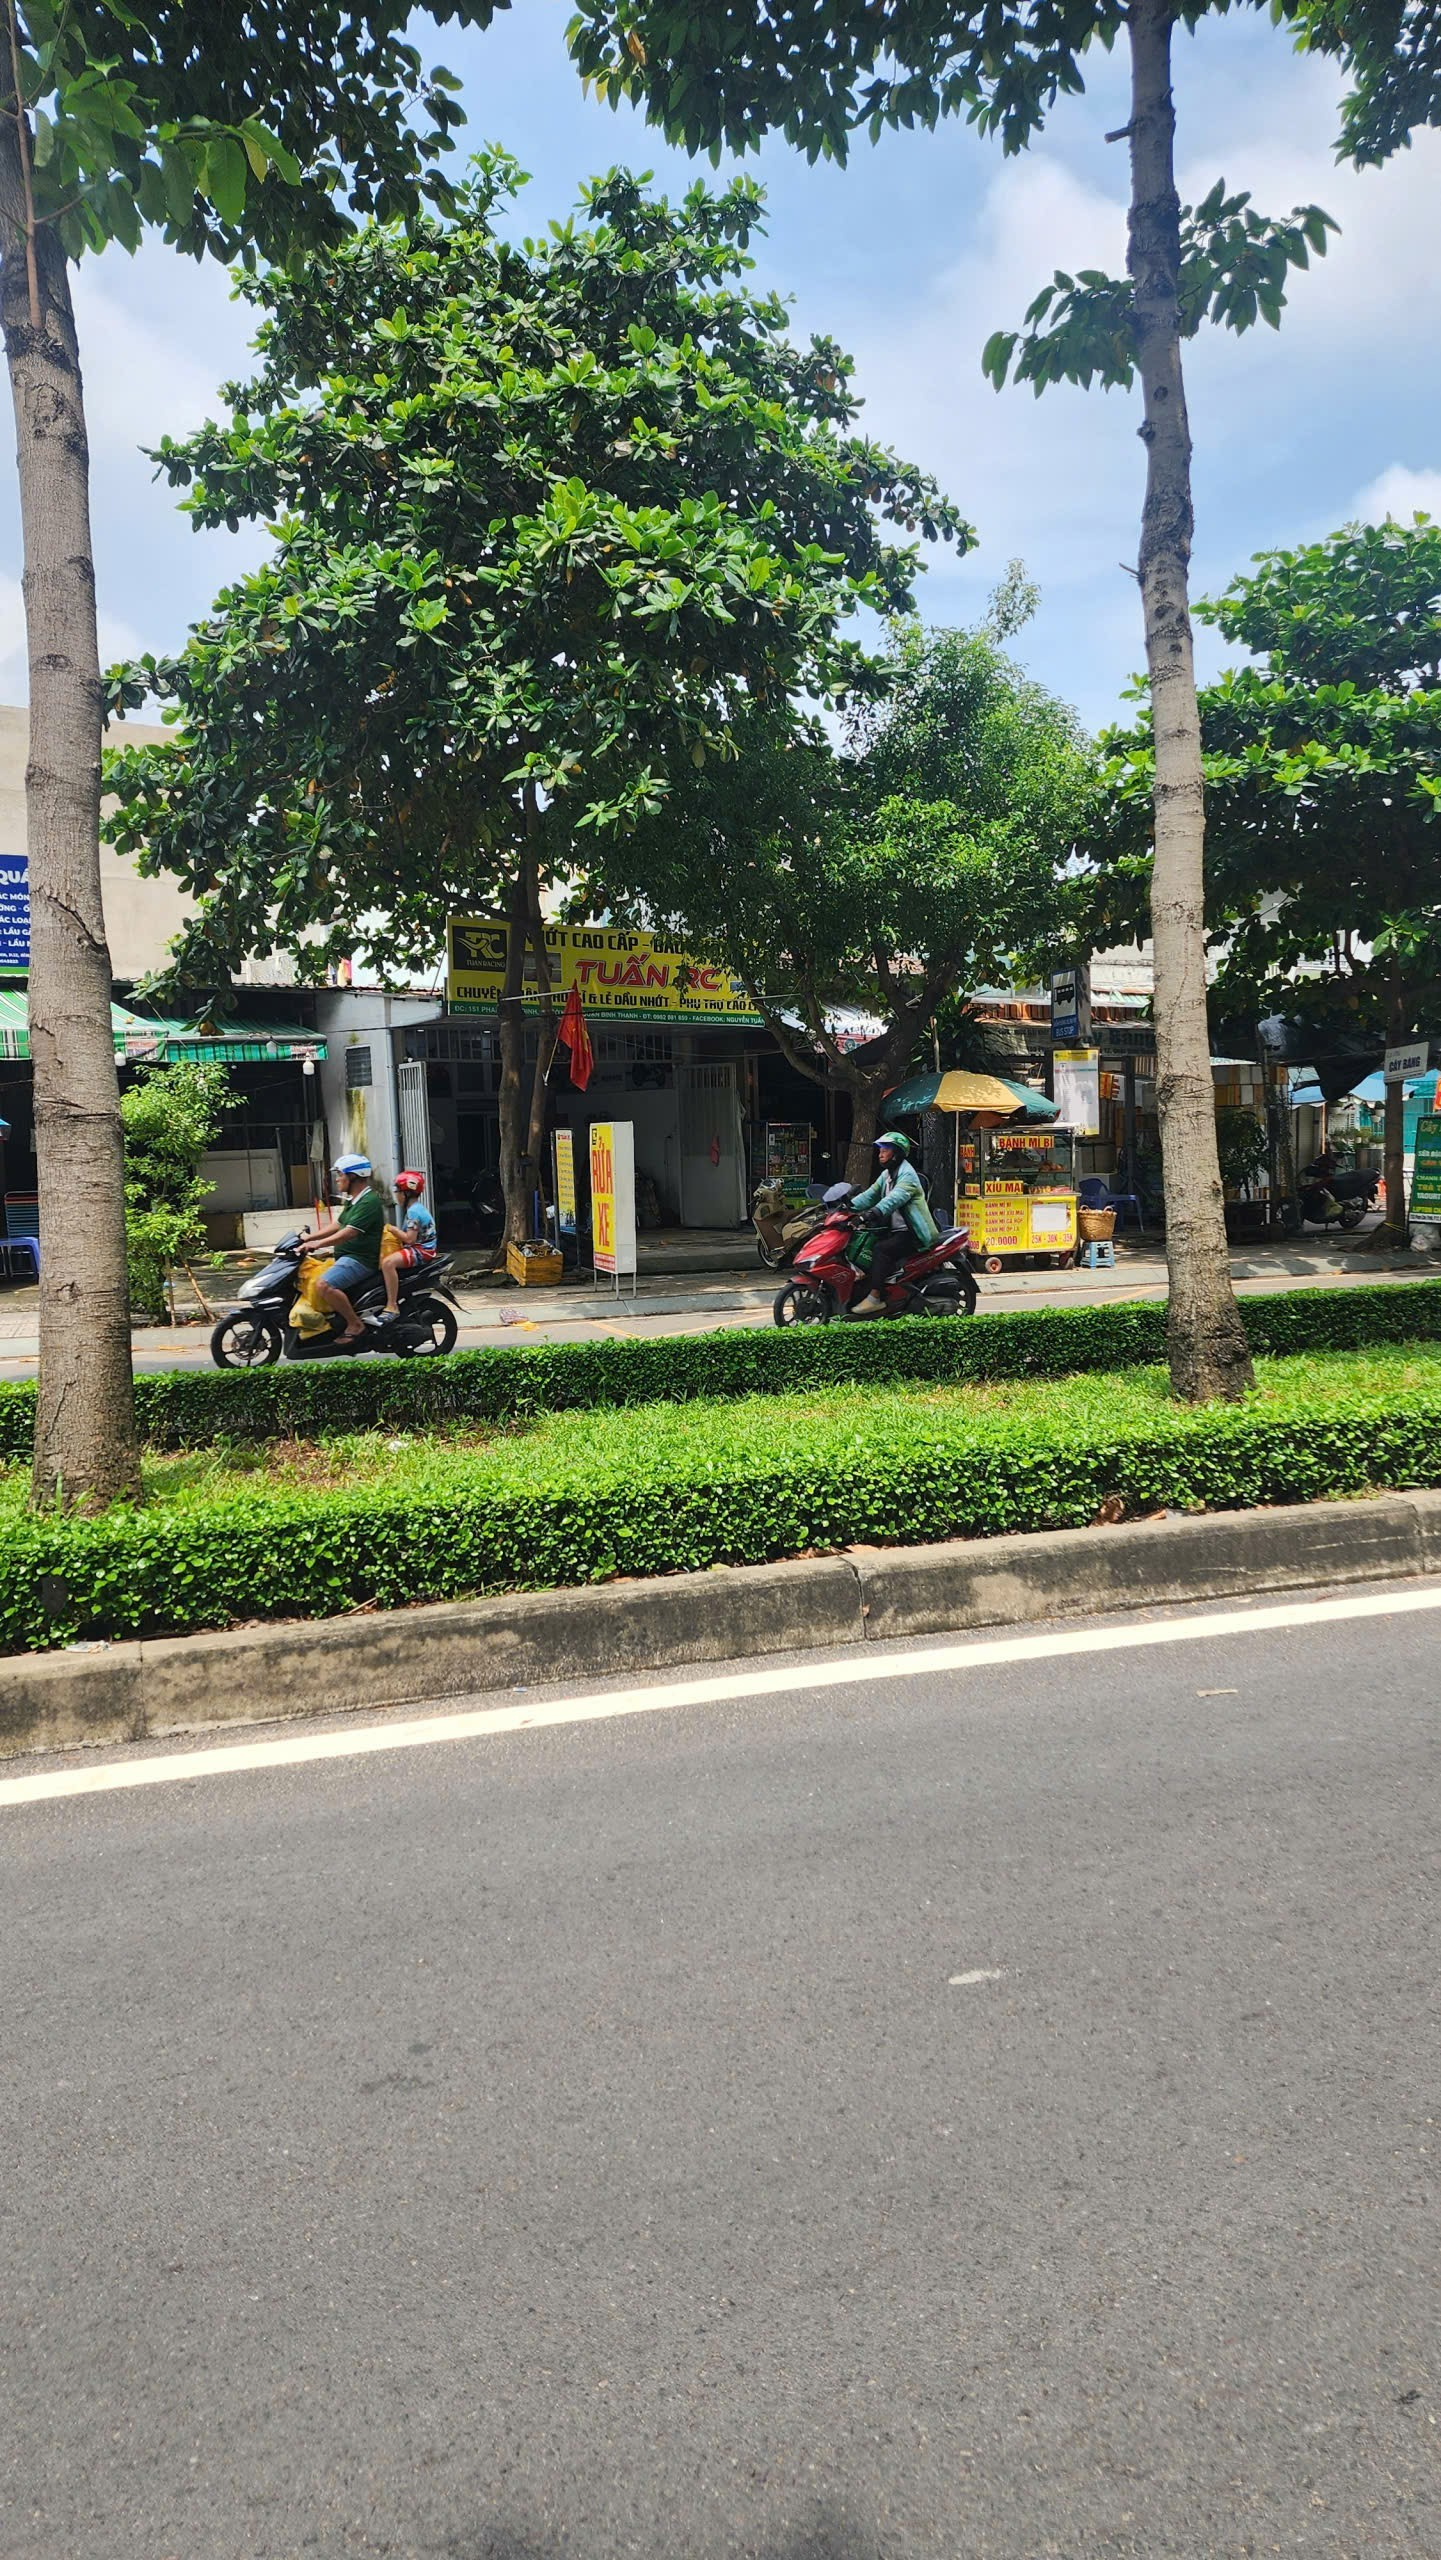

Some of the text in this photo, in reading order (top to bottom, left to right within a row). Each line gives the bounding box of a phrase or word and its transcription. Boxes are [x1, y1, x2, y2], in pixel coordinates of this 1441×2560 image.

[572, 932, 603, 949] CAO
[608, 931, 639, 951] CẤP
[484, 960, 506, 968] RACING
[575, 953, 669, 989] TUẤN
[639, 994, 670, 1008] NHỚT
[692, 1015, 725, 1023] FACEBOOK:
[597, 1202, 610, 1247] XE
